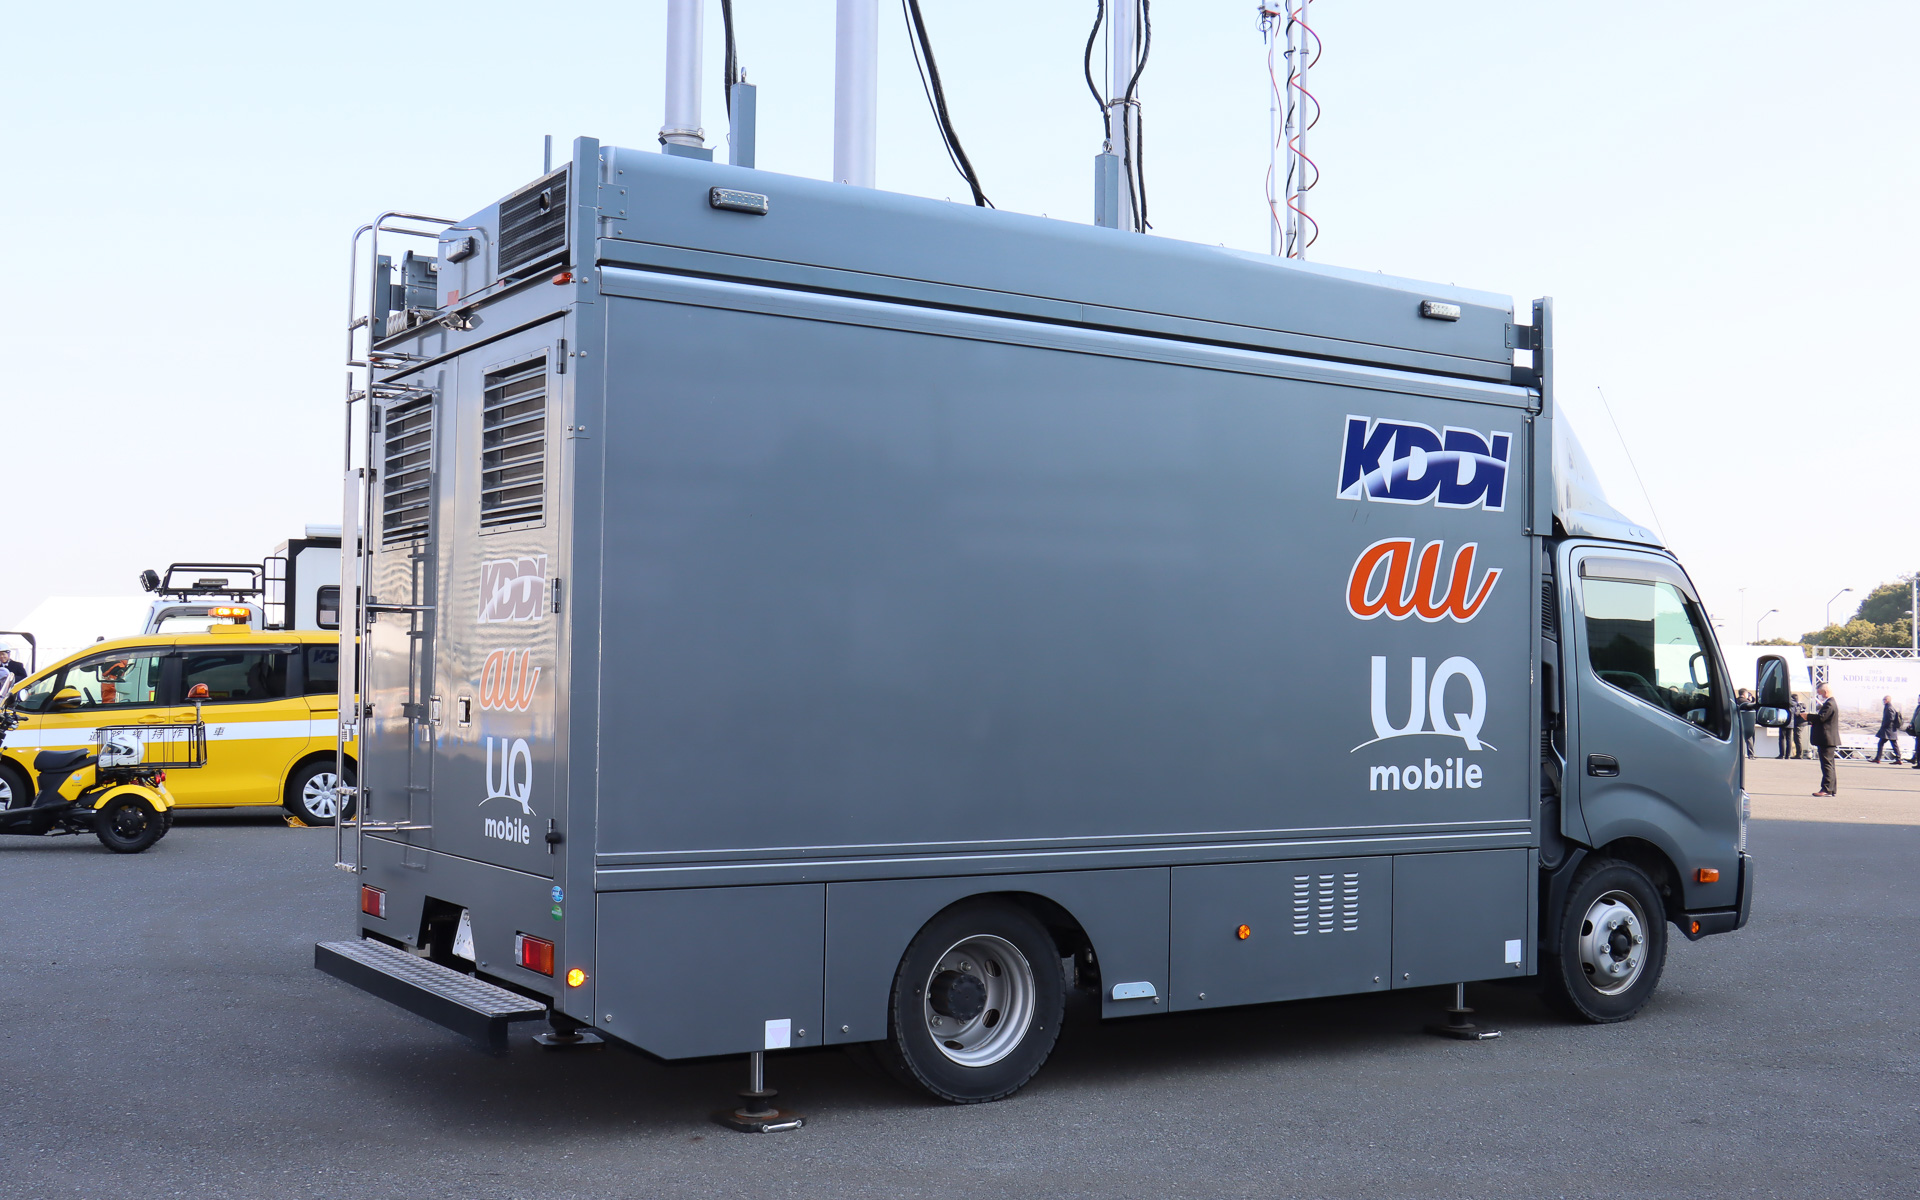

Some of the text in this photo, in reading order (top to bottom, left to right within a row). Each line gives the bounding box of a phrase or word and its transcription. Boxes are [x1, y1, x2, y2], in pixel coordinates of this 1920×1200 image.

[1337, 414, 1513, 512] KDDI
[477, 554, 548, 624] KDDI
[1346, 538, 1503, 624] au
[479, 648, 542, 712] au
[1371, 655, 1487, 751] UQ
[486, 736, 533, 815] UQ
[1370, 758, 1483, 791] mobile
[485, 817, 530, 845] mobile
